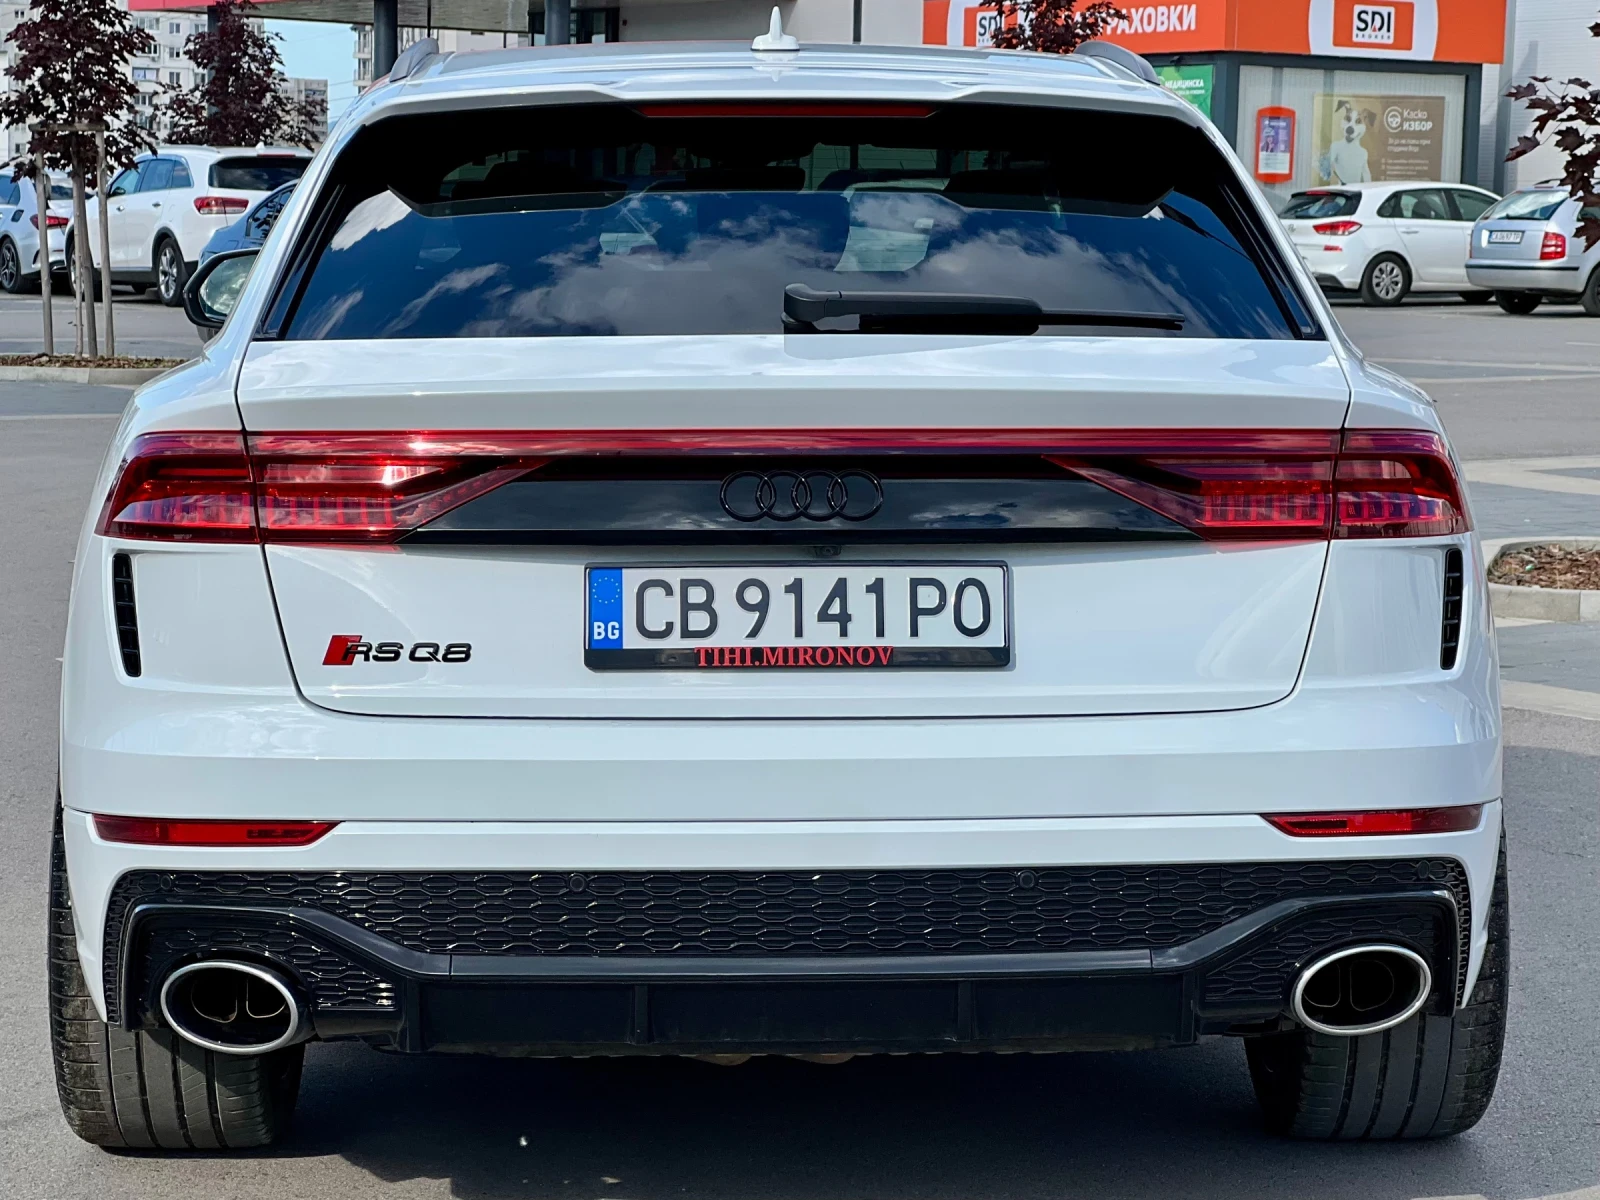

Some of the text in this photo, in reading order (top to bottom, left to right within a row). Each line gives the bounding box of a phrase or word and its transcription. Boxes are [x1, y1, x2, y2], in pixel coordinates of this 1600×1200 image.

[1356, 9, 1391, 33] SDI
[1403, 108, 1428, 119] Каско
[1403, 121, 1433, 131] ИЗБОР
[635, 578, 719, 640] CB
[735, 577, 886, 639] 9141
[593, 621, 620, 640] BG
[341, 641, 472, 663] RS Q8
[694, 646, 893, 667] TIHI.MIRONOV
